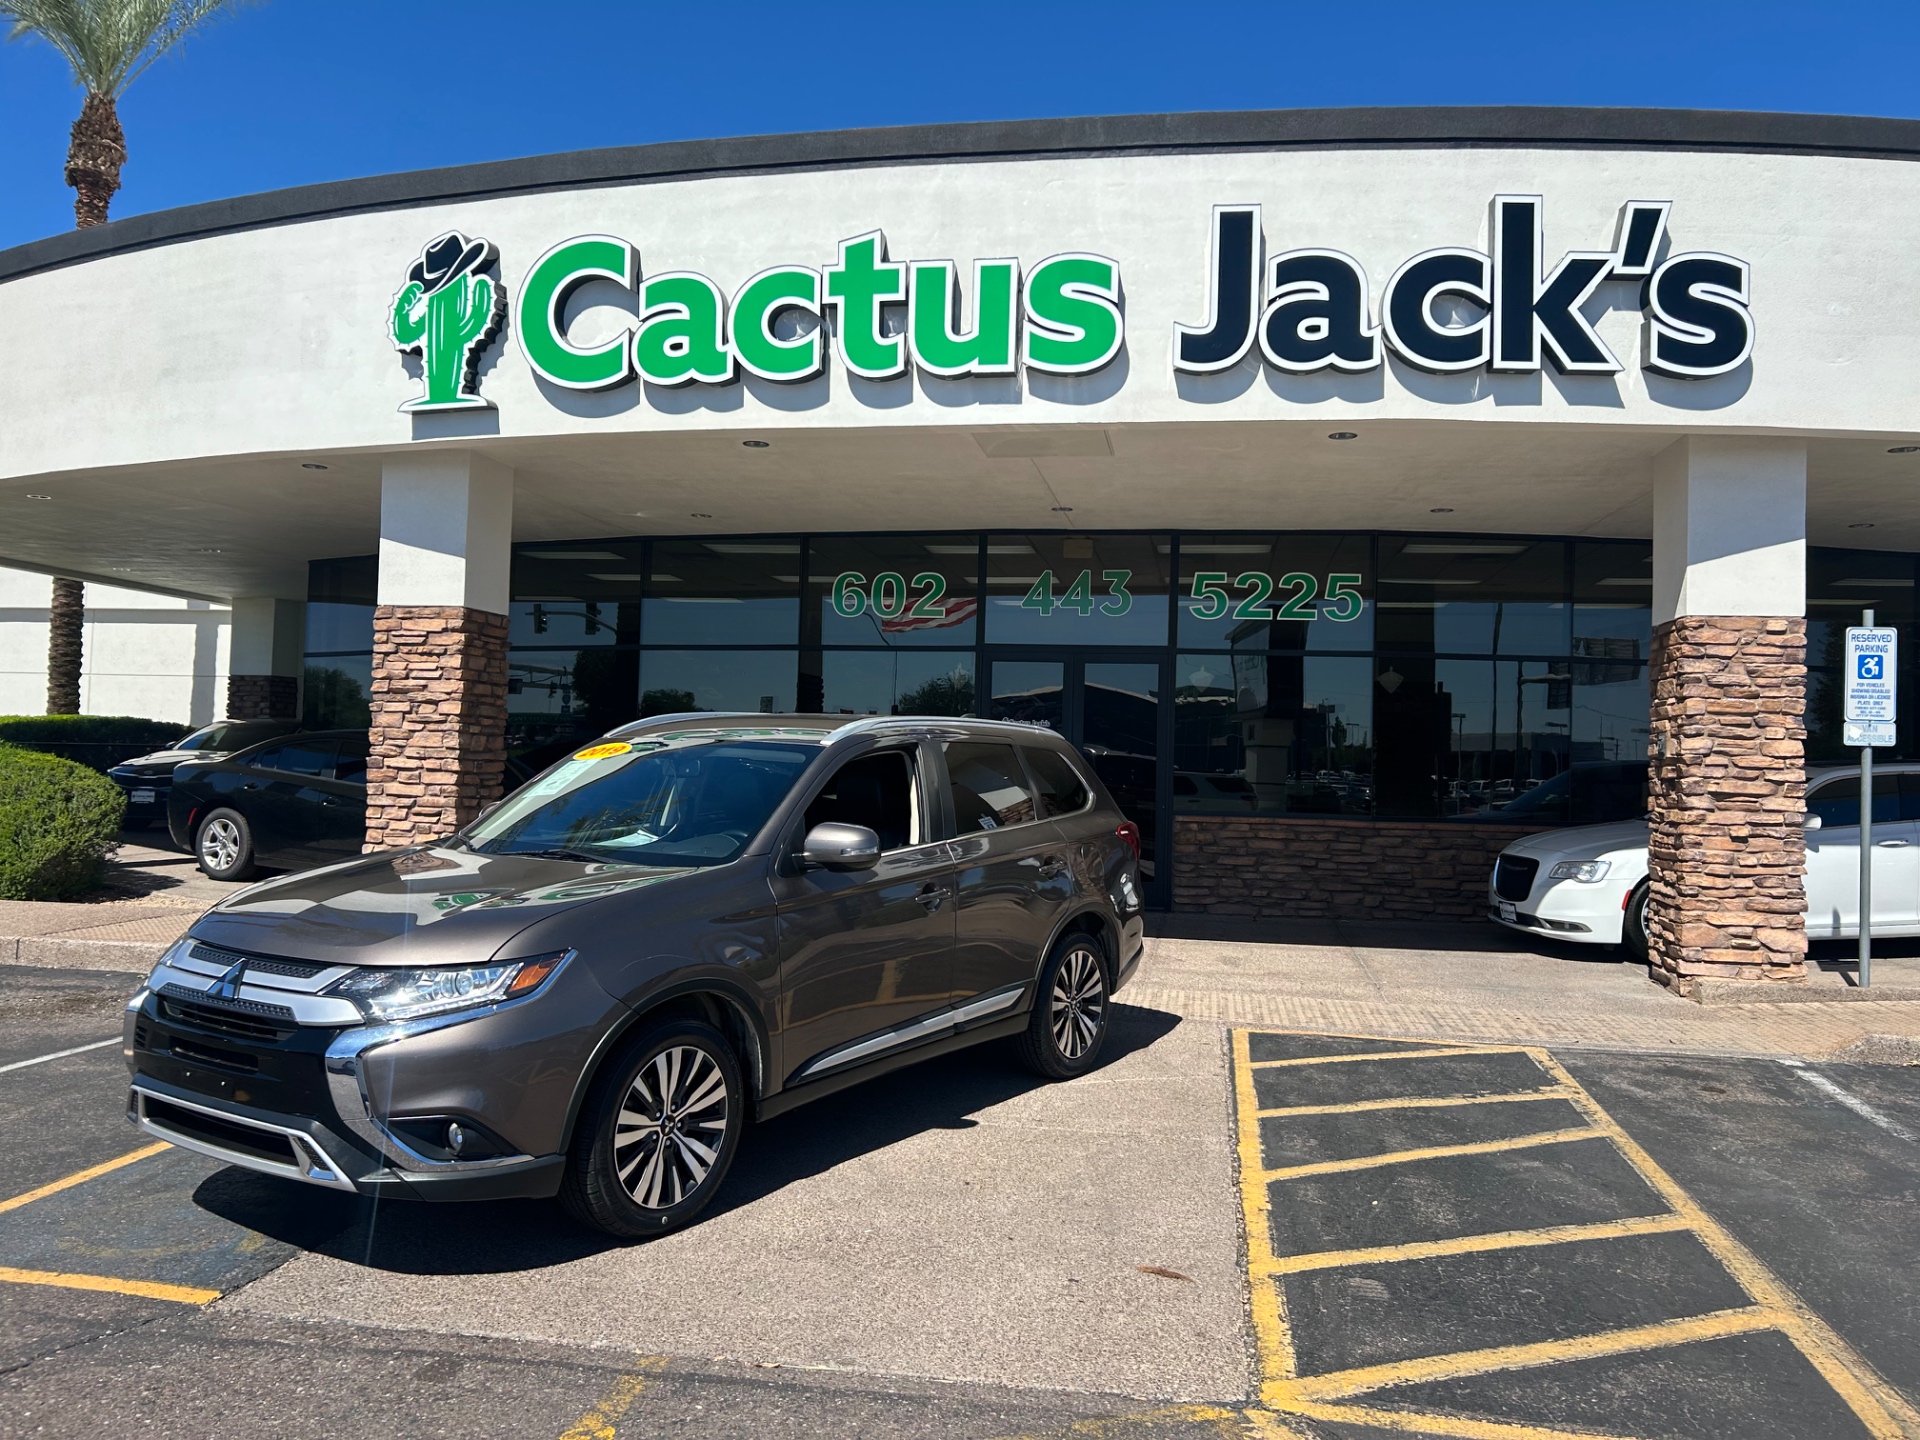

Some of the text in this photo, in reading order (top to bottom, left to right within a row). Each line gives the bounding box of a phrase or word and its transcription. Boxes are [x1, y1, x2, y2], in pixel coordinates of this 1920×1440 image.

[515, 194, 1757, 392] Cactus Jack's
[832, 569, 1364, 622] 602 443 5225
[1851, 633, 1893, 643] RESERVED
[1854, 644, 1889, 653] PARKING
[1862, 724, 1878, 733] VAN
[577, 745, 627, 758] 2019
